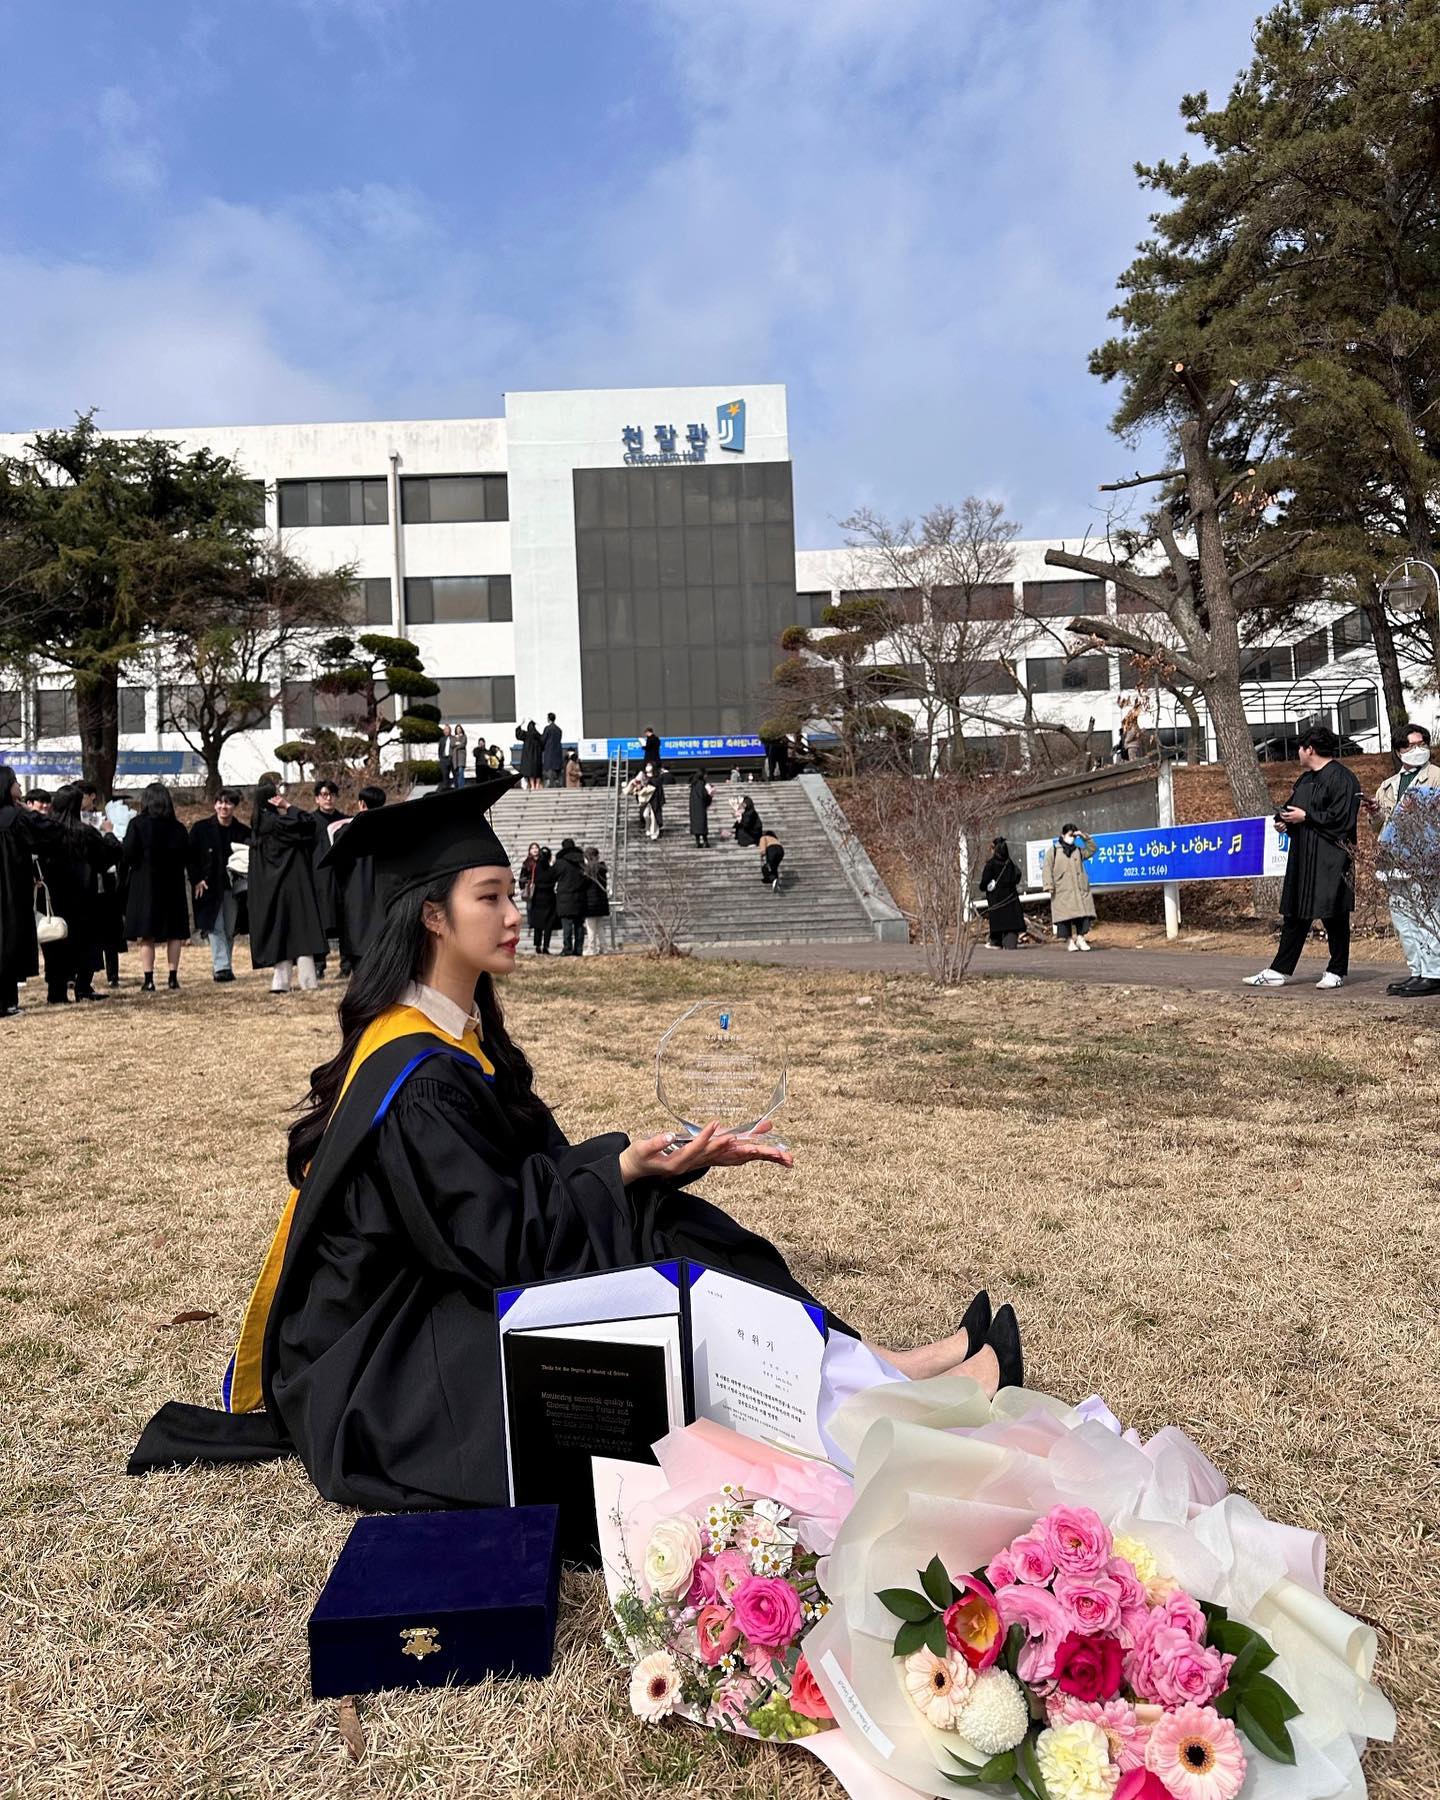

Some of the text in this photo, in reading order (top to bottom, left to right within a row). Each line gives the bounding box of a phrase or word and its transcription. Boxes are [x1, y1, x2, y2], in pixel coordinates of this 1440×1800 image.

[1099, 842, 1135, 864] 주인공은
[1123, 866, 1140, 876] 2023.
[1140, 866, 1147, 875] 2.
